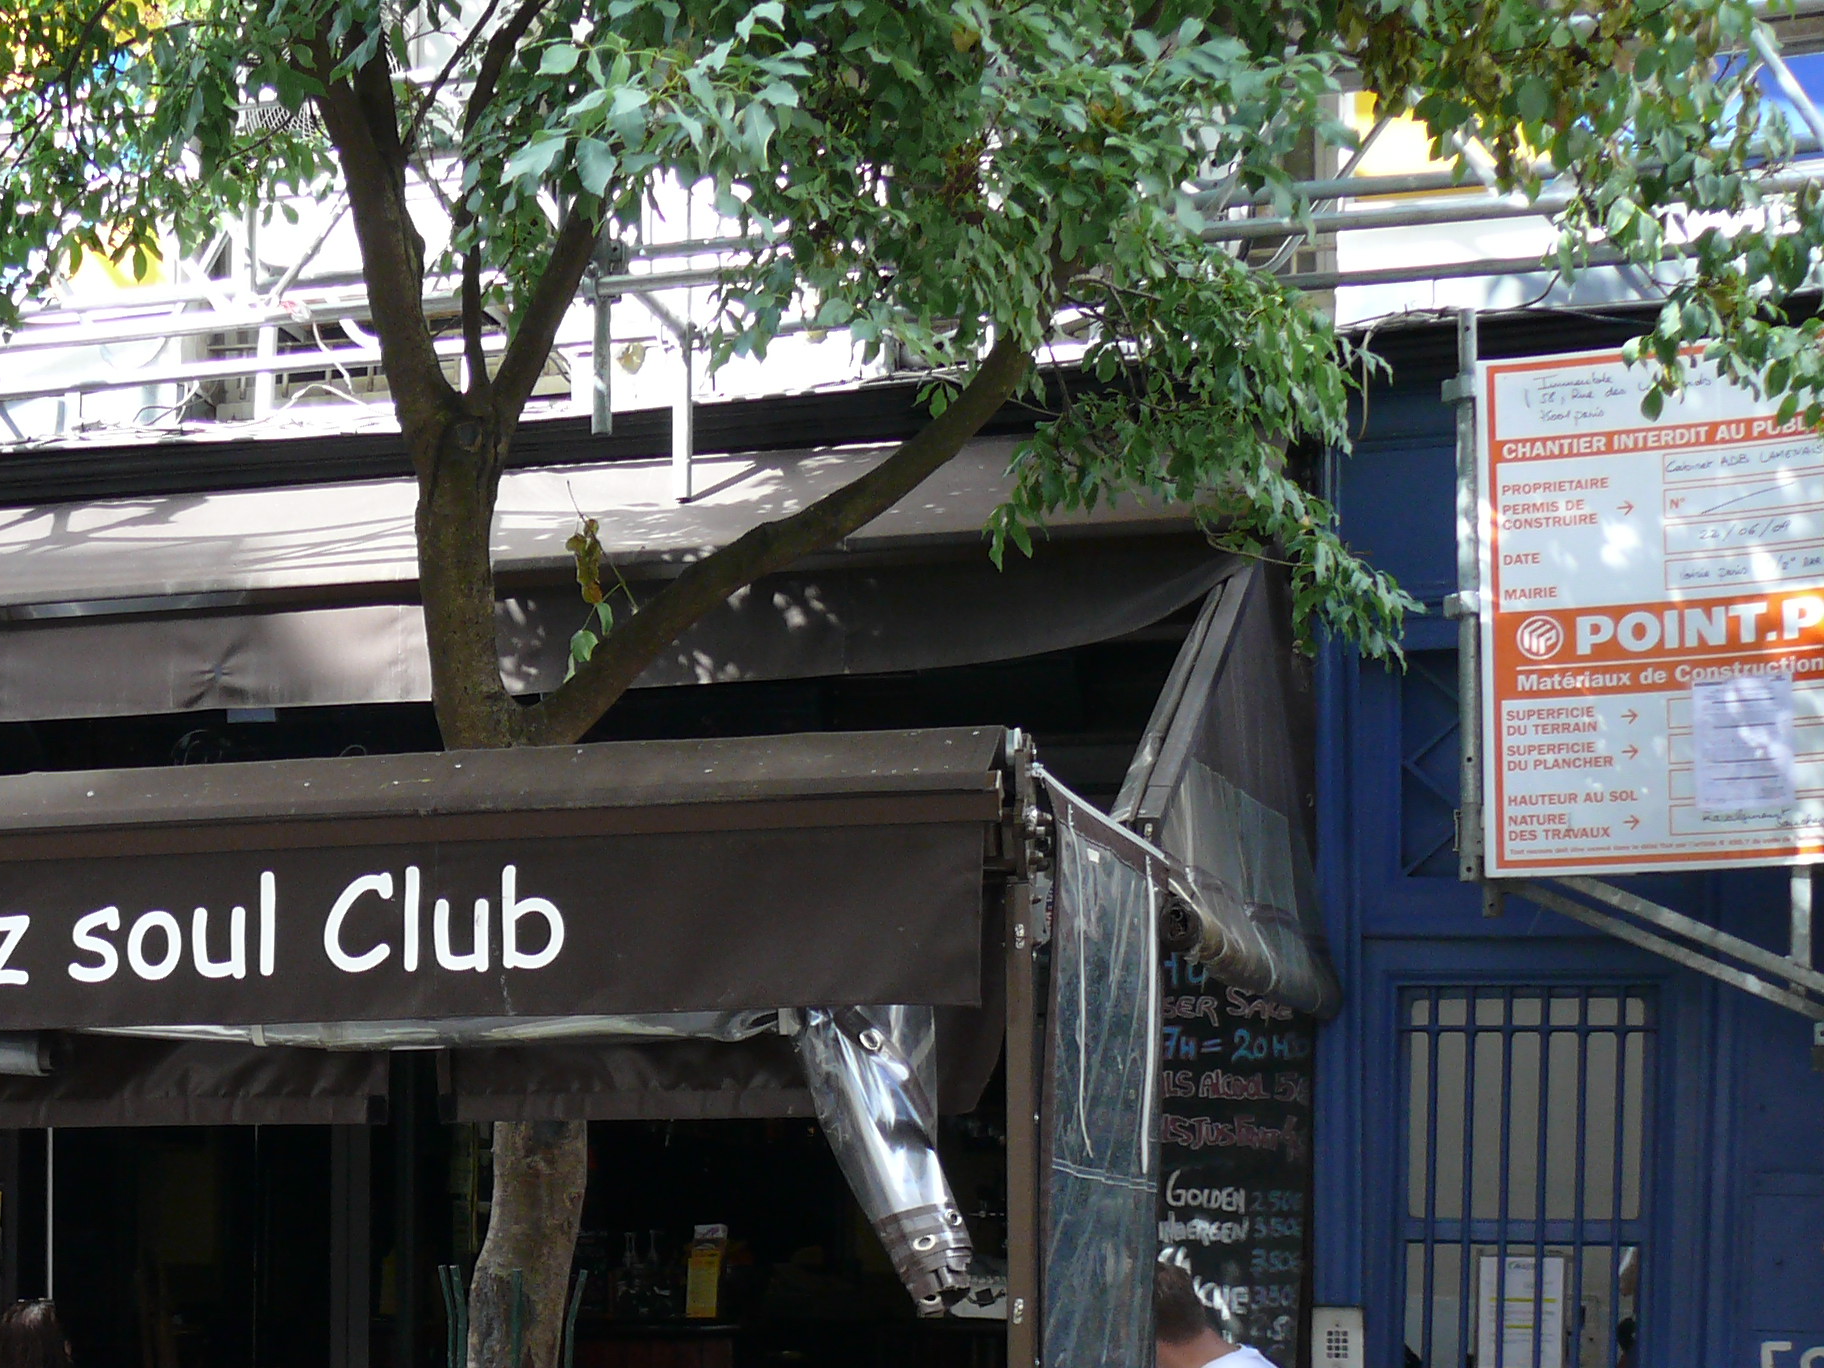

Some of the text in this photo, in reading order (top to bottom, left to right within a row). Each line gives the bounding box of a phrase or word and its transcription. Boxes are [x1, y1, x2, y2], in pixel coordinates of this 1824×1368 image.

[1502, 436, 1606, 460] CHANTIER
[1613, 426, 1710, 451] INTERDIT
[1715, 422, 1745, 442] AU
[1502, 477, 1610, 497] PROPRIETAIRE
[1502, 499, 1585, 516] PERMIS DE
[1502, 513, 1599, 531] CONSTRUIRE
[1503, 553, 1541, 567] DATE
[1504, 586, 1558, 601] MAIRIE
[1575, 596, 1824, 656] POINT.P
[1517, 670, 1632, 692] Matériaux
[1639, 667, 1667, 685] de
[1506, 705, 1595, 722] SUPERFICIE
[1506, 721, 1598, 738] DU TERRAIN
[1507, 741, 1596, 758] SUPERFICIE
[1507, 755, 1614, 773] DU PLANCHER
[1508, 789, 1639, 807] HAUTEUR AU SOL
[1508, 812, 1567, 827] NATURE
[1508, 826, 1611, 843] DES TRAVAUX
[68, 870, 276, 984] soul
[322, 864, 565, 974] Club
